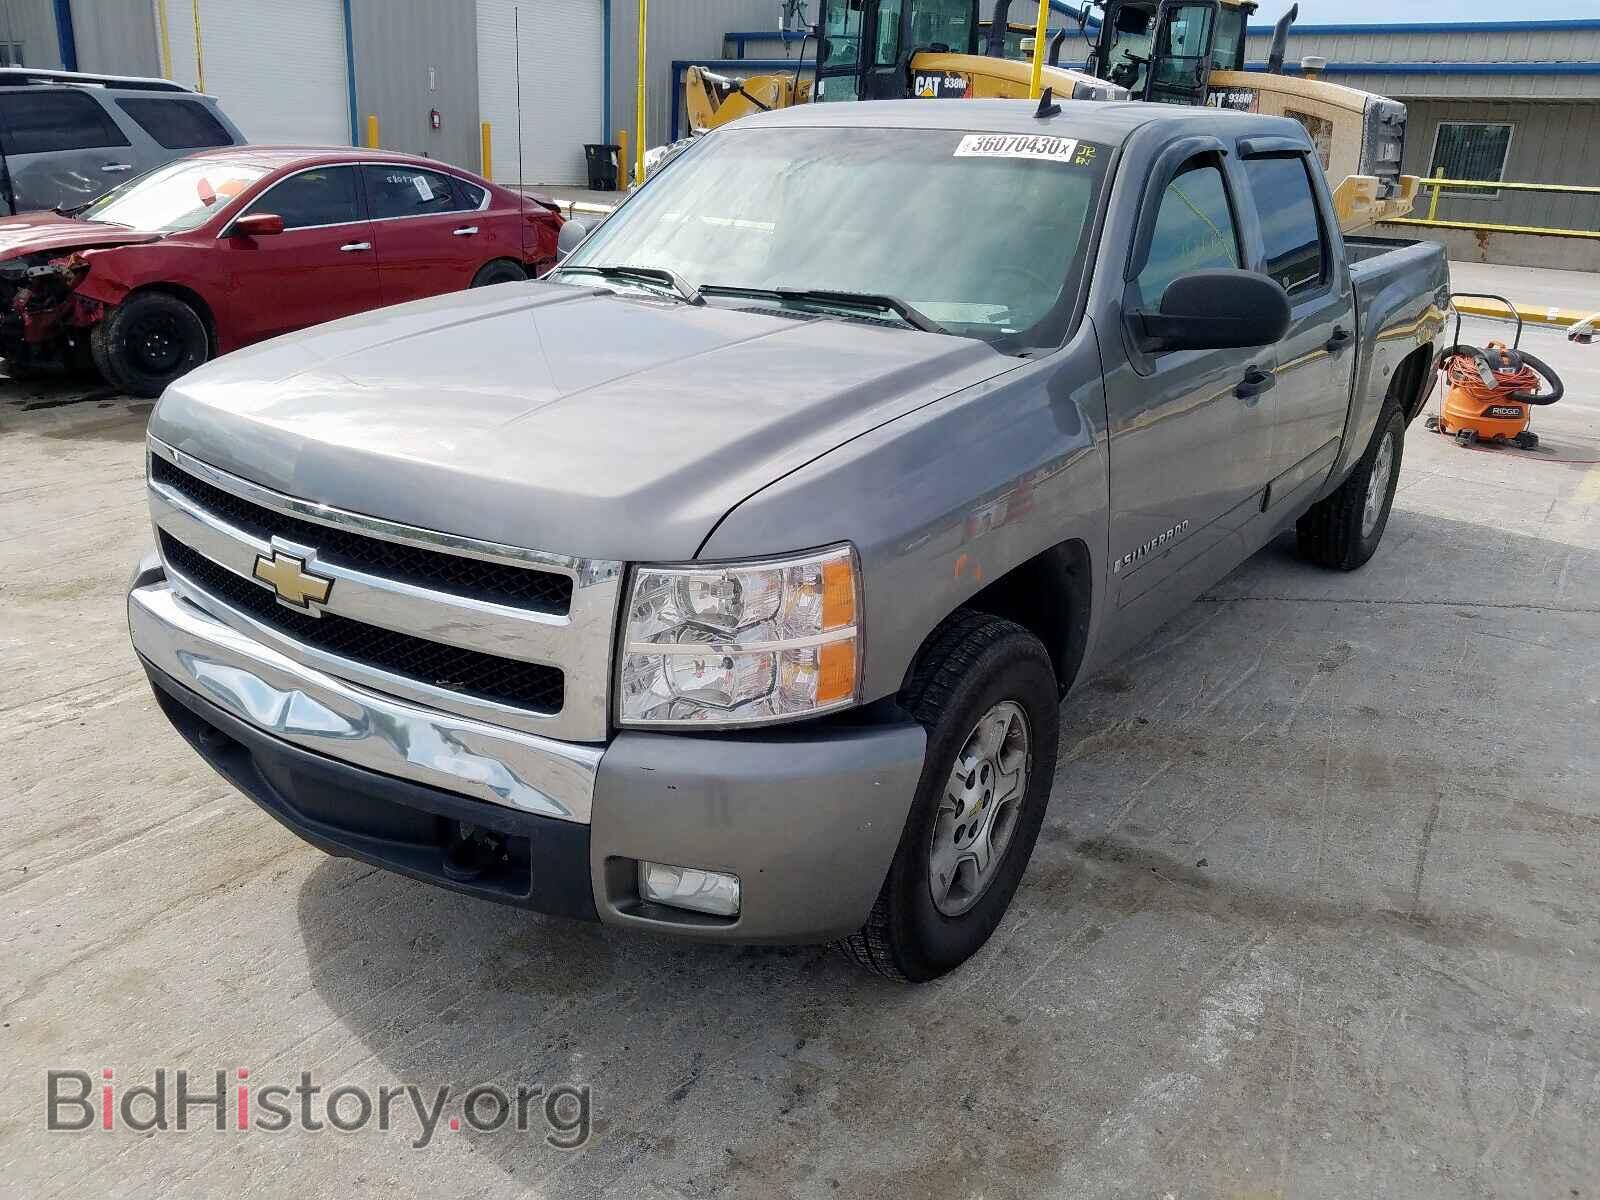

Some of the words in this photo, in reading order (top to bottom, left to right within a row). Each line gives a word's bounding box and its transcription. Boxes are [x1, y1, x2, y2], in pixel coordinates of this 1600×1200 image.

[915, 76, 942, 97] CAT
[944, 77, 967, 89] 938M
[1207, 92, 1227, 109] AT
[1492, 406, 1520, 415] RIDGID
[1124, 519, 1190, 564] SILVERADO
